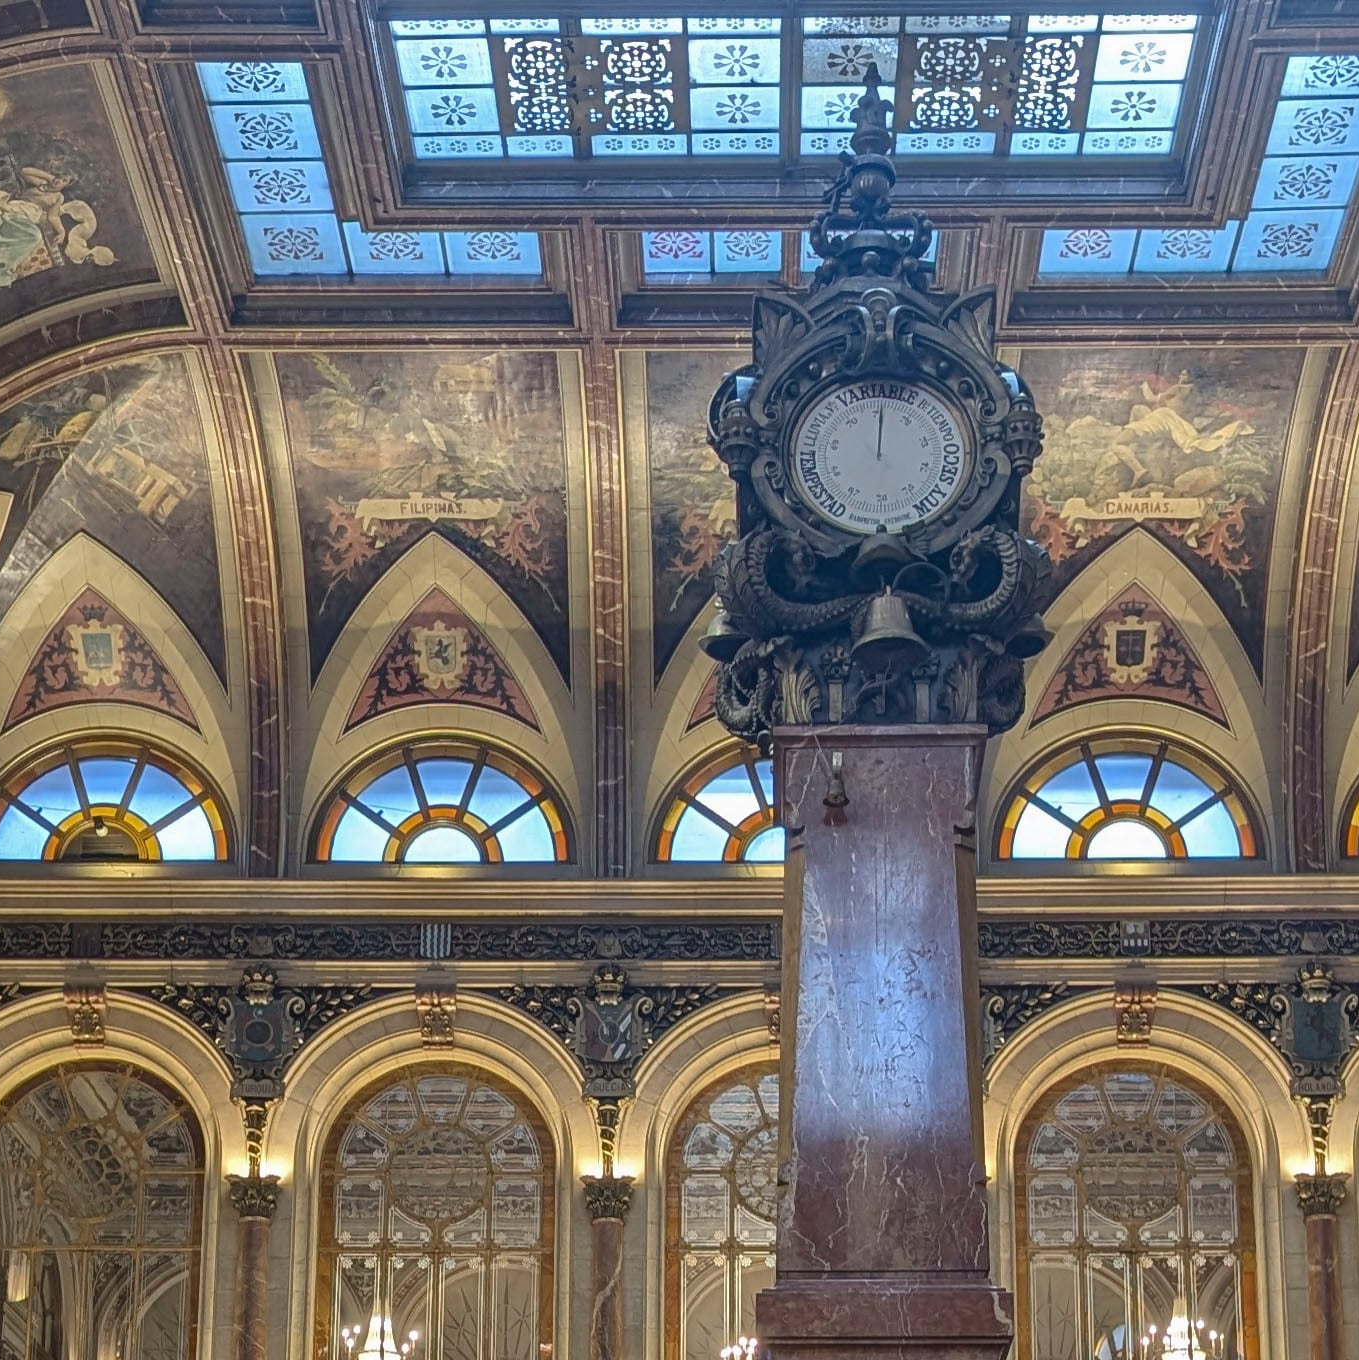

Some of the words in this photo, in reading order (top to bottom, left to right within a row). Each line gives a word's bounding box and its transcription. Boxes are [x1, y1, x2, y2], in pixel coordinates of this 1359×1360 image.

[835, 384, 918, 407] VARIABLE
[800, 450, 846, 518] TEMPESTAD
[912, 486, 947, 518] MUY
[940, 443, 960, 486] SECO
